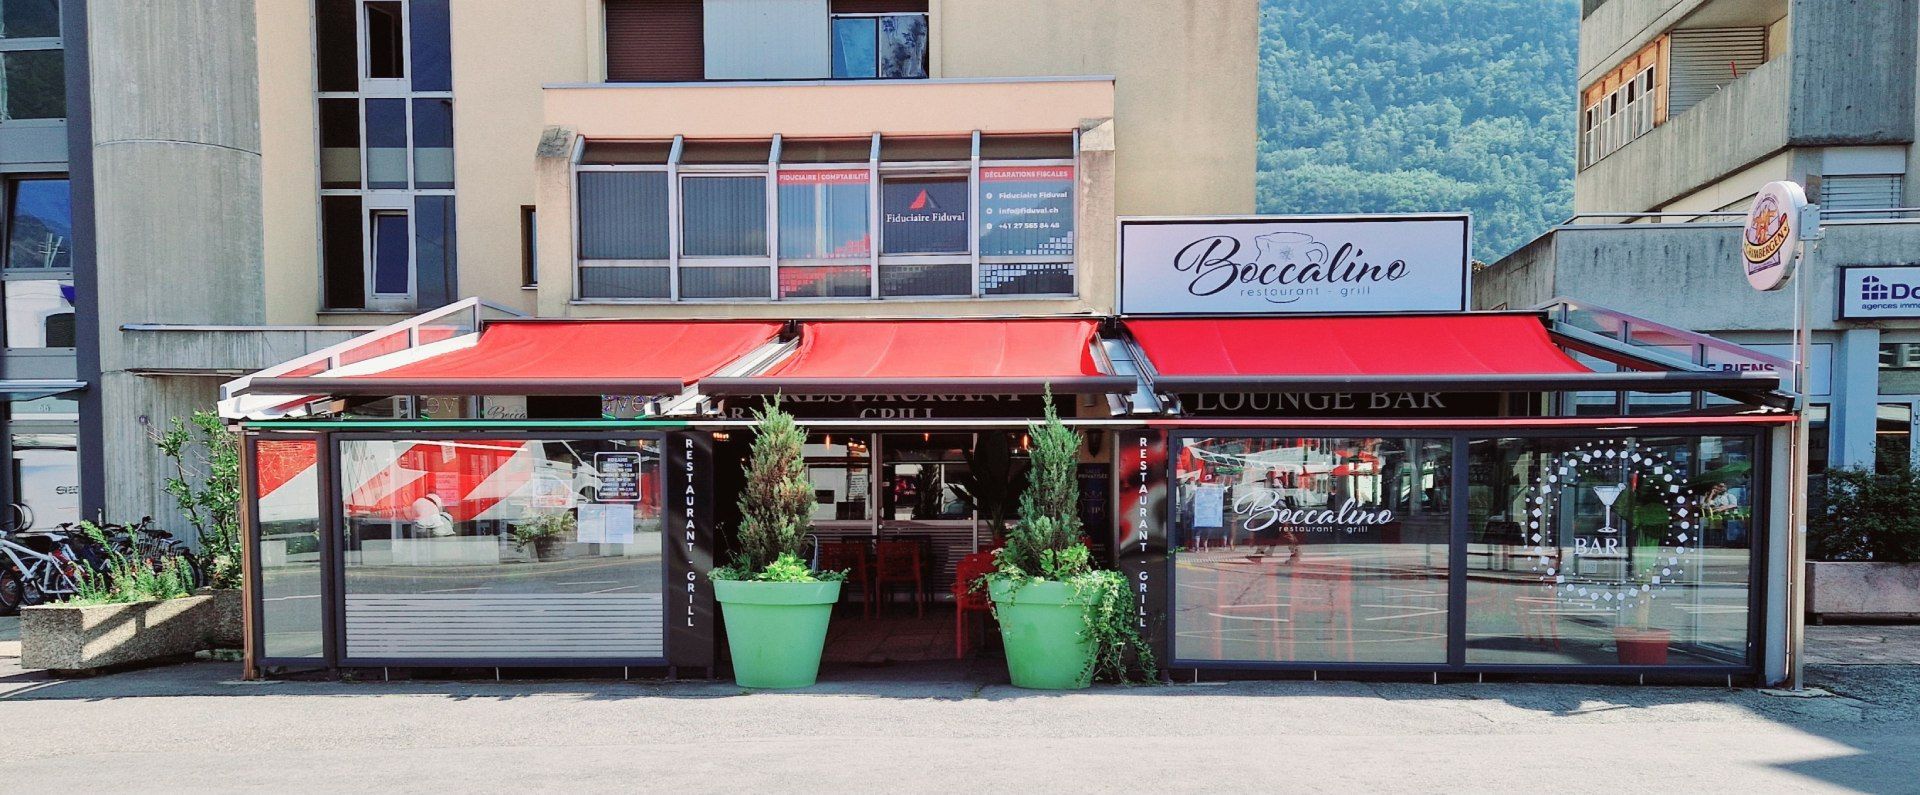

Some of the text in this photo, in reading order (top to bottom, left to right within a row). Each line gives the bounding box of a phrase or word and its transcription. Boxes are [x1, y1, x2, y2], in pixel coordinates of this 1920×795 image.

[821, 172, 869, 180] COMPTABILITÉ
[984, 170, 1036, 178] DÉCLARATIONS
[999, 191, 1038, 199] Fiduciaire
[886, 211, 965, 223] Fiduciaire Fiduval
[1173, 235, 1410, 297] Boccalino
[1240, 287, 1319, 297] restaurant
[1340, 285, 1371, 298] grill
[1195, 392, 1446, 411] LOUNGE BAR
[685, 438, 696, 552] RESTAURANT
[1138, 437, 1149, 552] RESTAURANT
[1233, 491, 1394, 531] Boccalino
[1278, 525, 1333, 533] restaurant
[1346, 525, 1368, 534] grill
[1574, 537, 1619, 556] BAR
[686, 571, 697, 627] GRILL
[1138, 571, 1149, 627] GRILL
